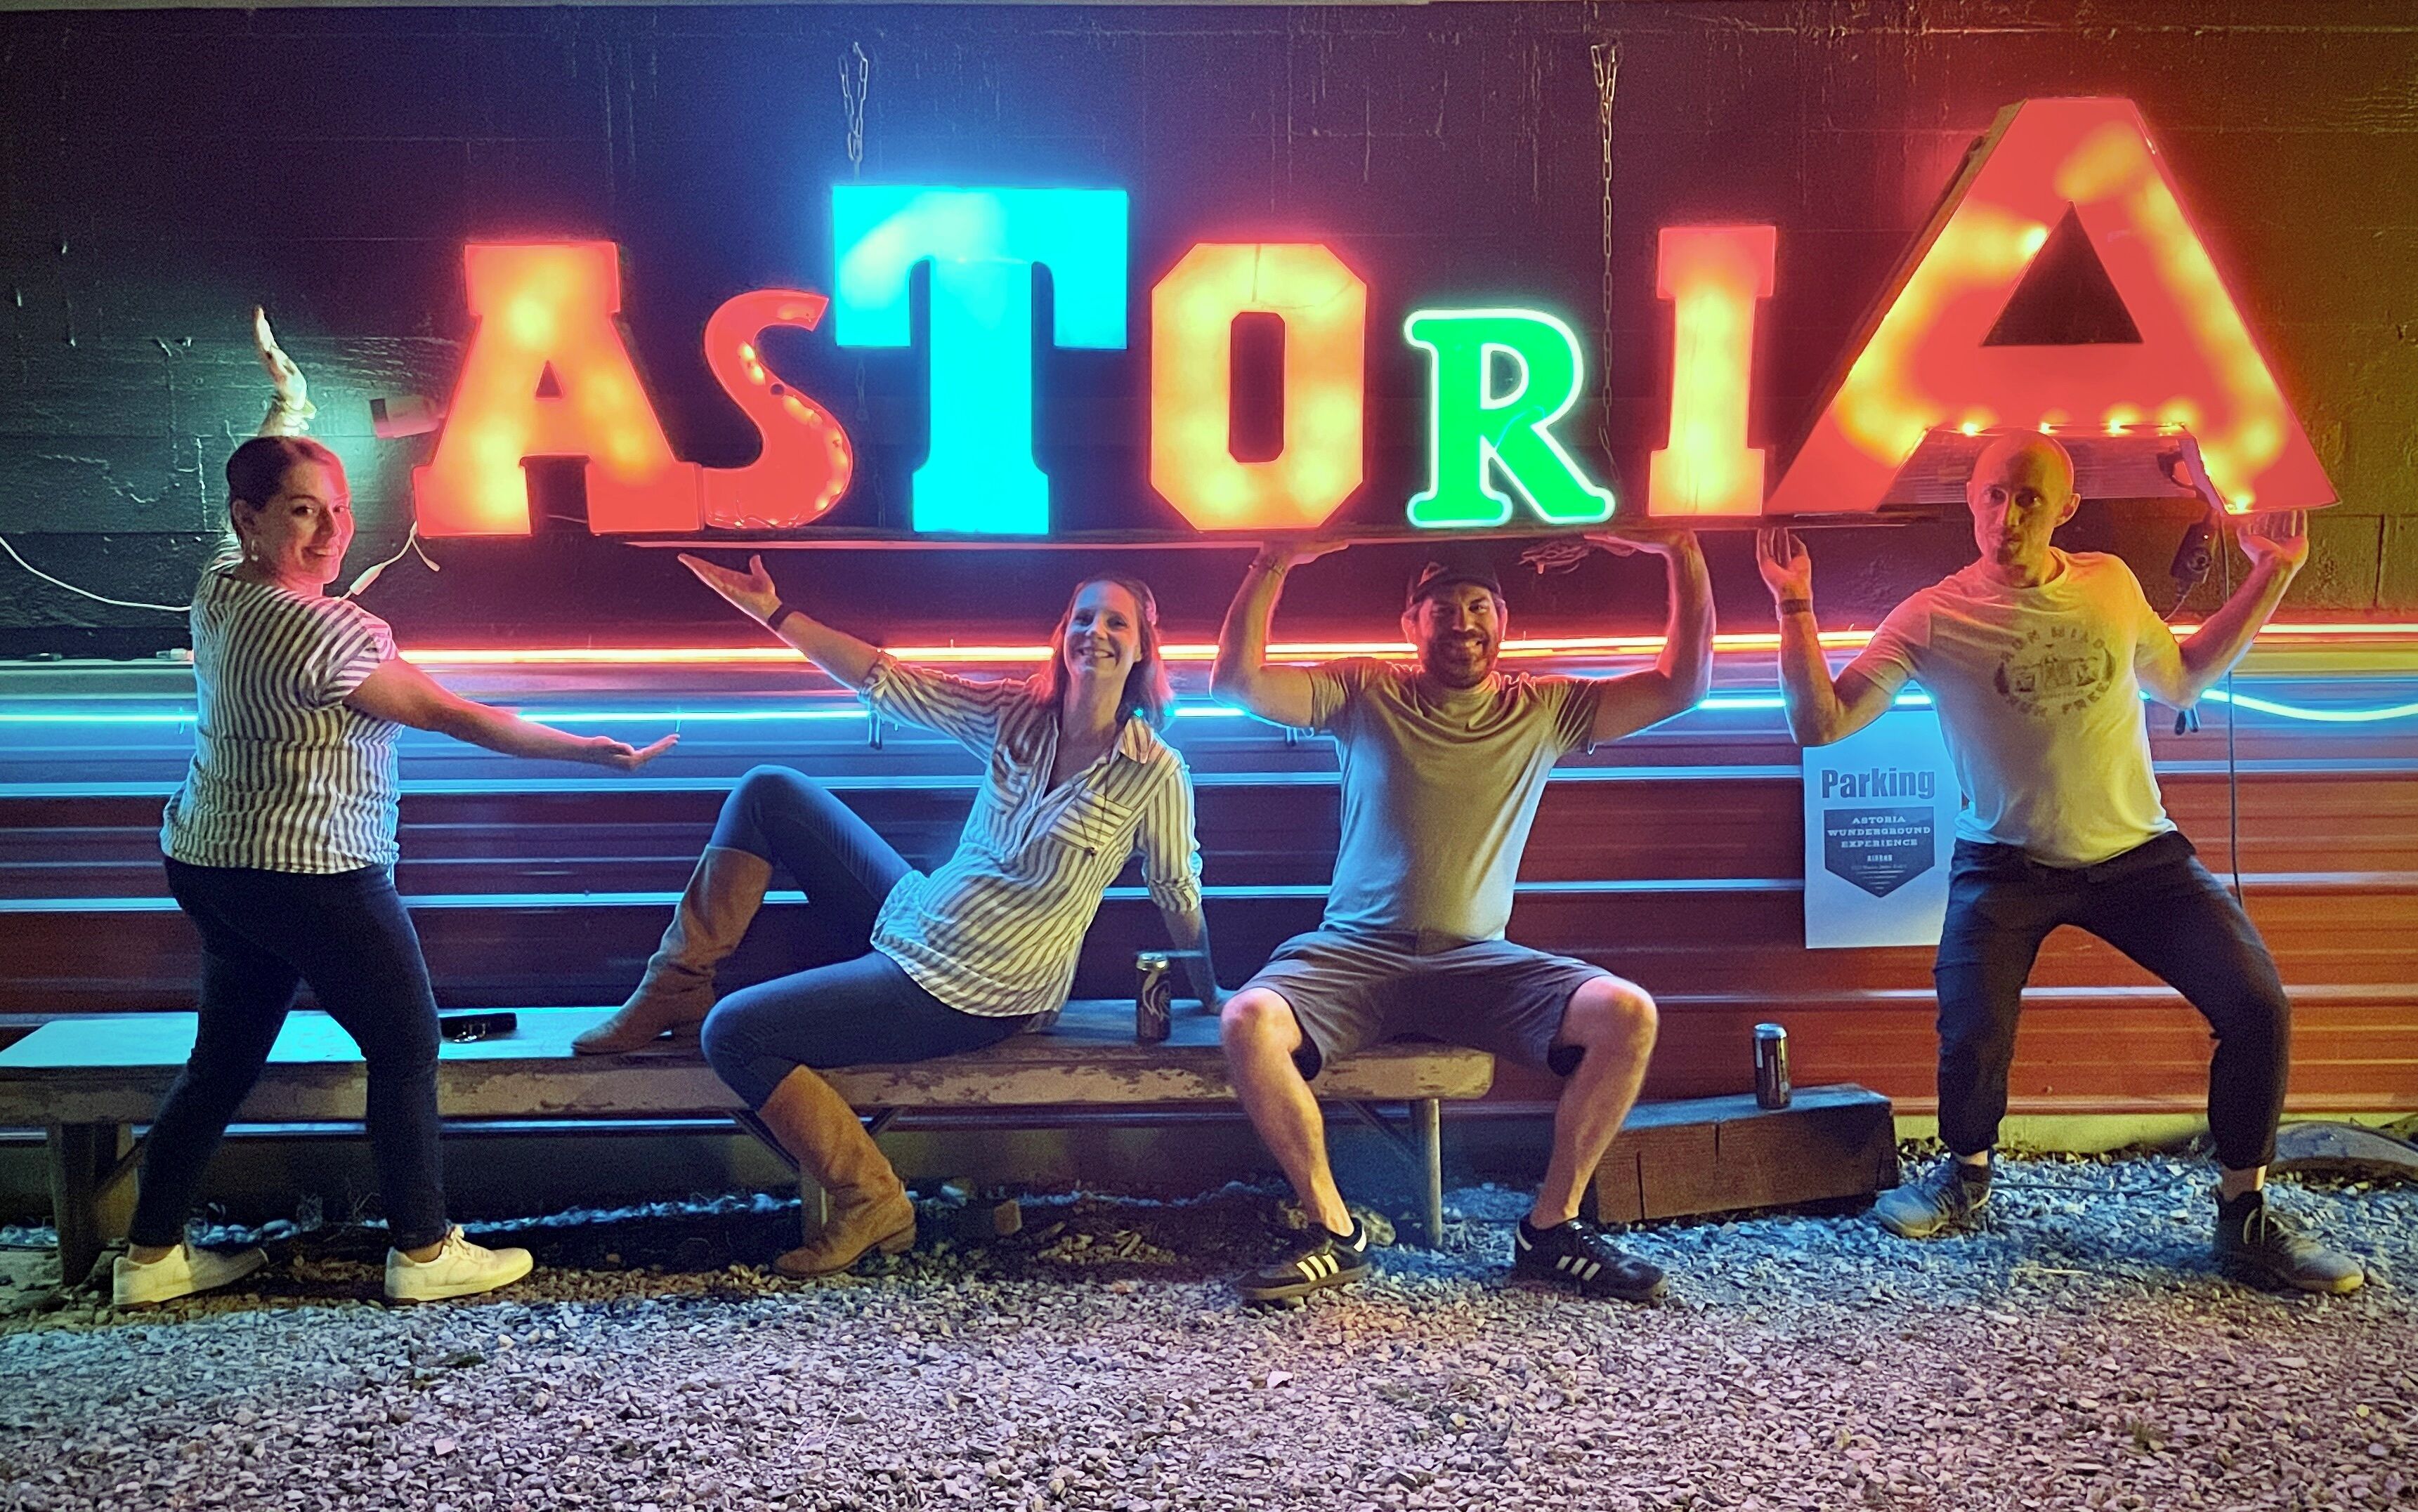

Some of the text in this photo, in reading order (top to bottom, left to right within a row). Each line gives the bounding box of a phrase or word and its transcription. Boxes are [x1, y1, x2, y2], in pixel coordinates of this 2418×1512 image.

[412, 96, 2342, 538] ASTORIA
[1821, 768, 1935, 800] Parking
[1852, 815, 1906, 824] ASTORIA
[1827, 826, 1931, 836] WUNDERGROUND
[1841, 839, 1918, 848] EXPERIENCE
